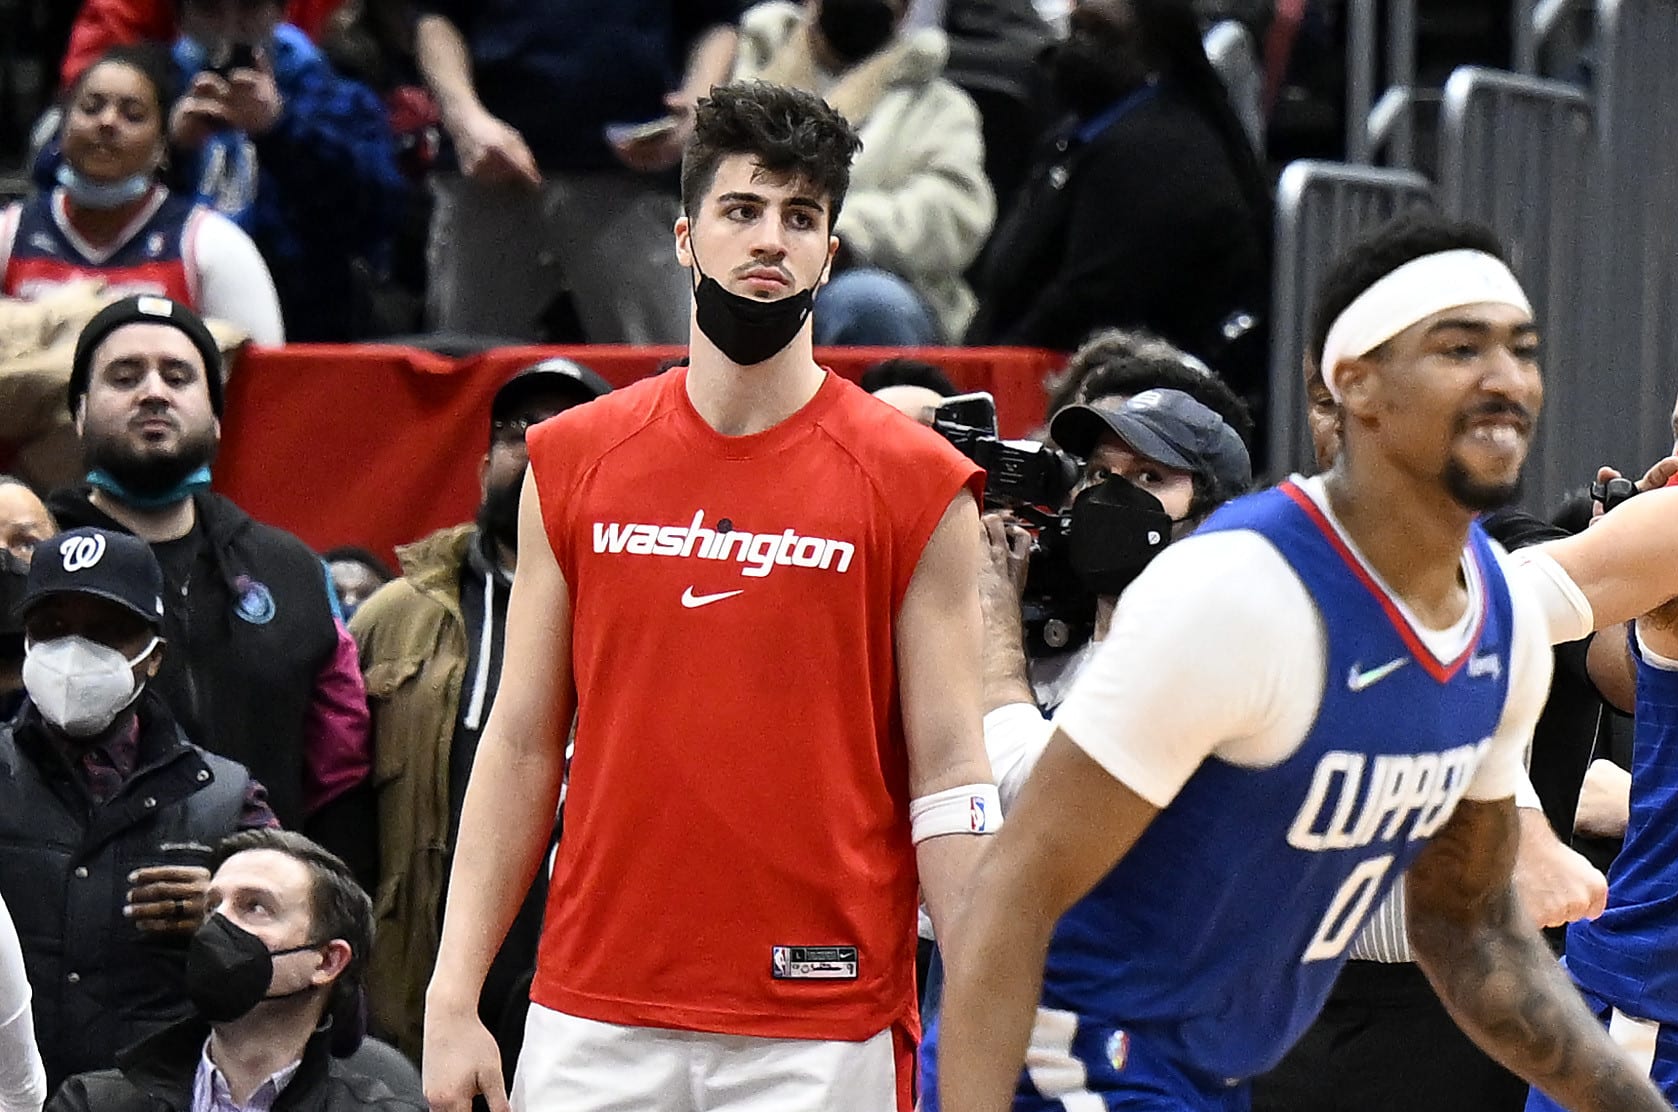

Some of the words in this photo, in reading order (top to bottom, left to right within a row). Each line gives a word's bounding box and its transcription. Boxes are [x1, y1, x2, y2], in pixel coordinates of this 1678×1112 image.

[60, 533, 106, 572] W
[593, 509, 855, 577] washington
[1286, 738, 1492, 851] CLIPPER
[1301, 852, 1396, 964] 0
